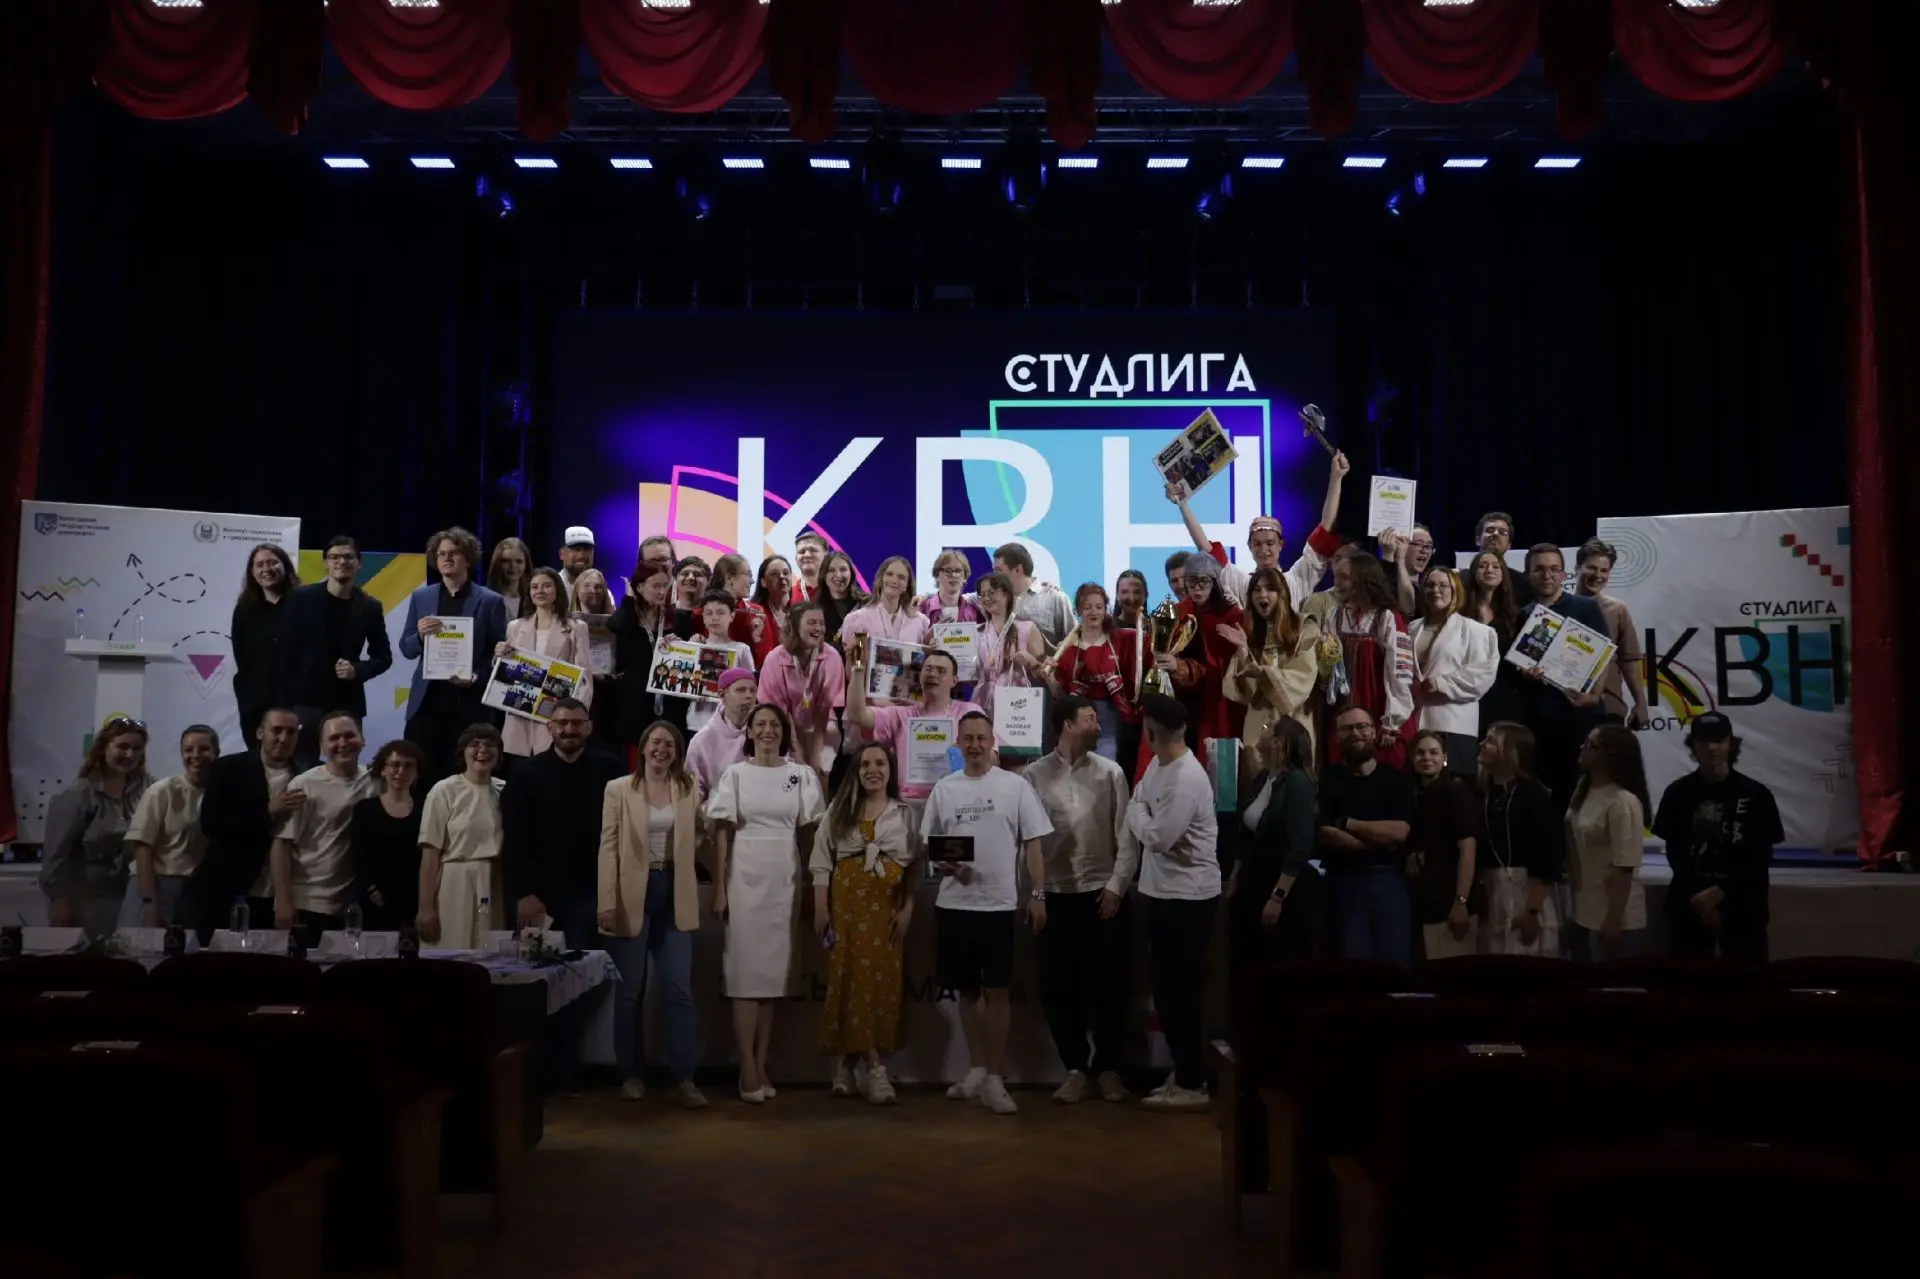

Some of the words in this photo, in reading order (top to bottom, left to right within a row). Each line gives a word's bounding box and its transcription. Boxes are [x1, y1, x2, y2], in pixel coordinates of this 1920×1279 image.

[1005, 353, 1256, 398] СТУДЛИГА
[738, 436, 1261, 600] КВН
[1739, 600, 1837, 616] СТУДЛИГА
[1645, 623, 1846, 707] КВН
